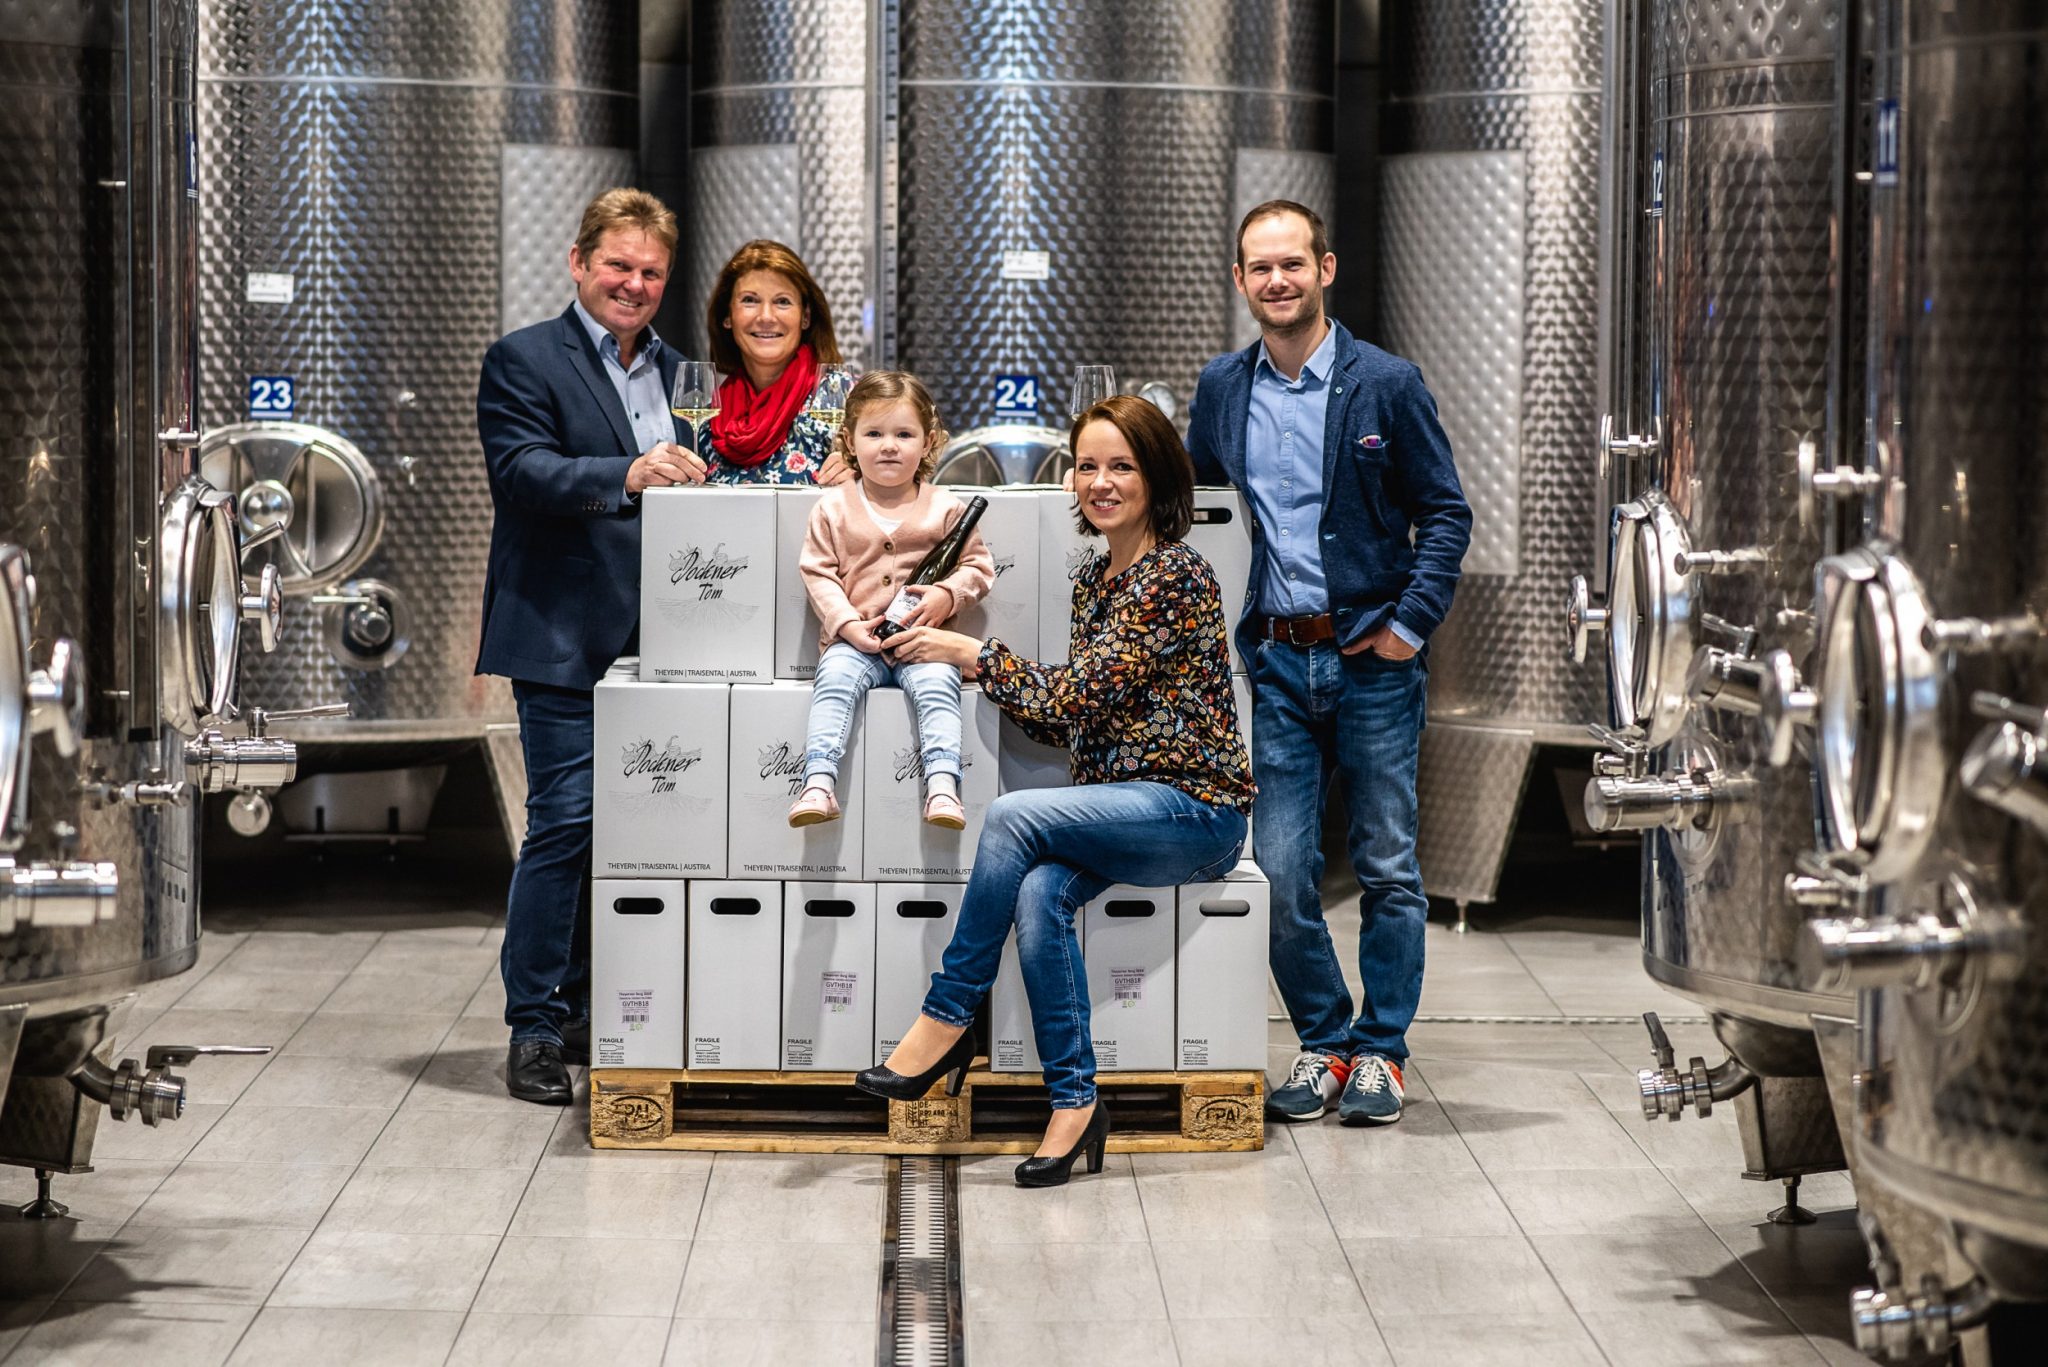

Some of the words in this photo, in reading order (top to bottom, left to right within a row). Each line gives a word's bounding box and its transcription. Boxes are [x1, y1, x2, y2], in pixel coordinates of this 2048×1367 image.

[1653, 159, 1663, 202] 12
[252, 379, 292, 410] 23
[996, 379, 1037, 409] 24
[670, 546, 748, 585] Dockner
[698, 582, 723, 601] Tom
[687, 669, 725, 677] TRAISENTAL
[623, 739, 702, 778] Dockner
[760, 741, 806, 780] Dock
[651, 775, 677, 794] Tom
[607, 862, 637, 870] THEYERN
[743, 864, 773, 872] THEYERN
[777, 864, 815, 872] TRAISENTAL
[819, 865, 847, 873] AUSTRIA
[878, 867, 908, 875] THEYERN
[912, 867, 950, 875] TRAISENTAL
[825, 981, 853, 989] GVTHB18
